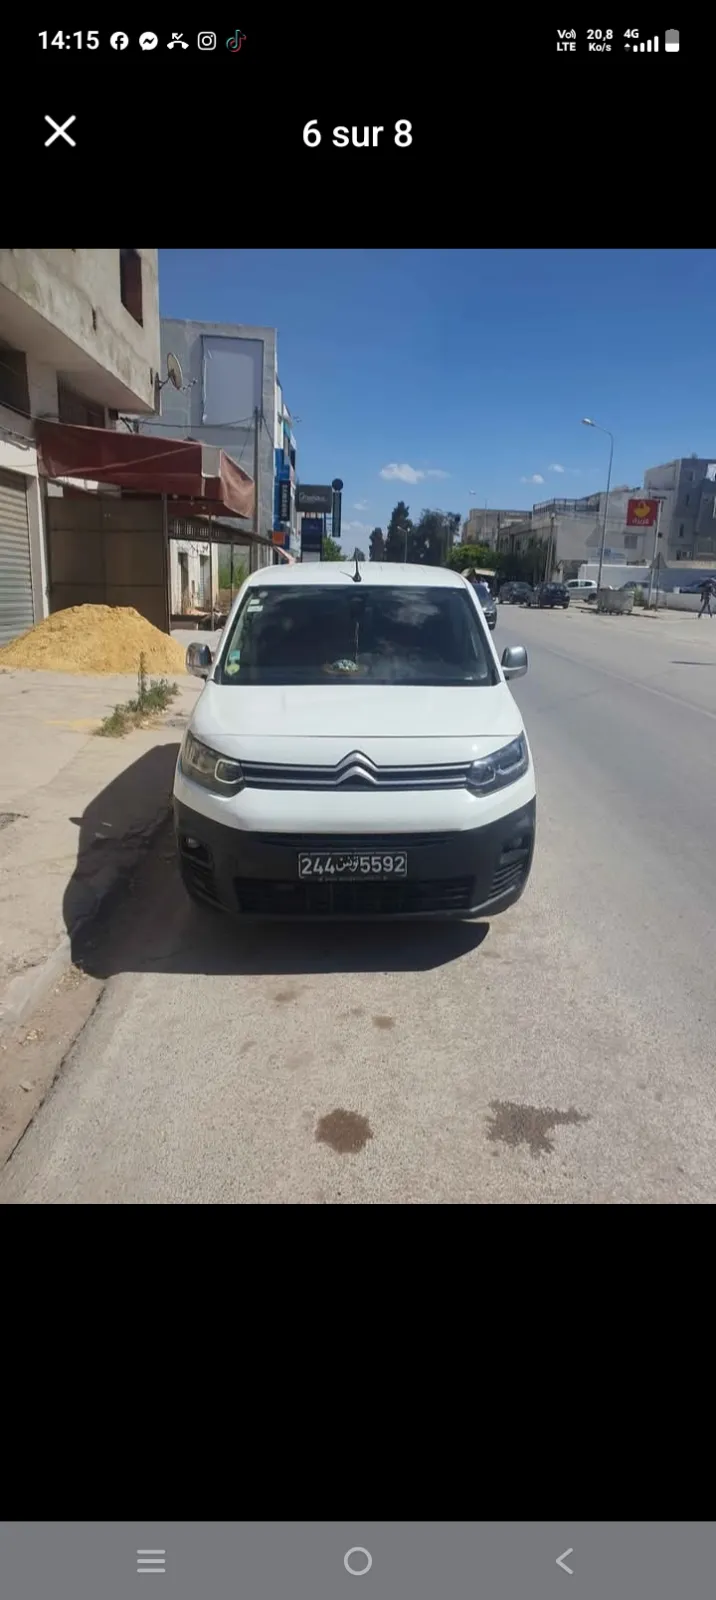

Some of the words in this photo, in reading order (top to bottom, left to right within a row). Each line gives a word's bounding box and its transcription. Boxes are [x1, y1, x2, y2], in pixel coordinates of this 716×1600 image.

[301, 857, 335, 875] 244
[335, 855, 359, 872] تونس
[359, 855, 405, 873] 5592
